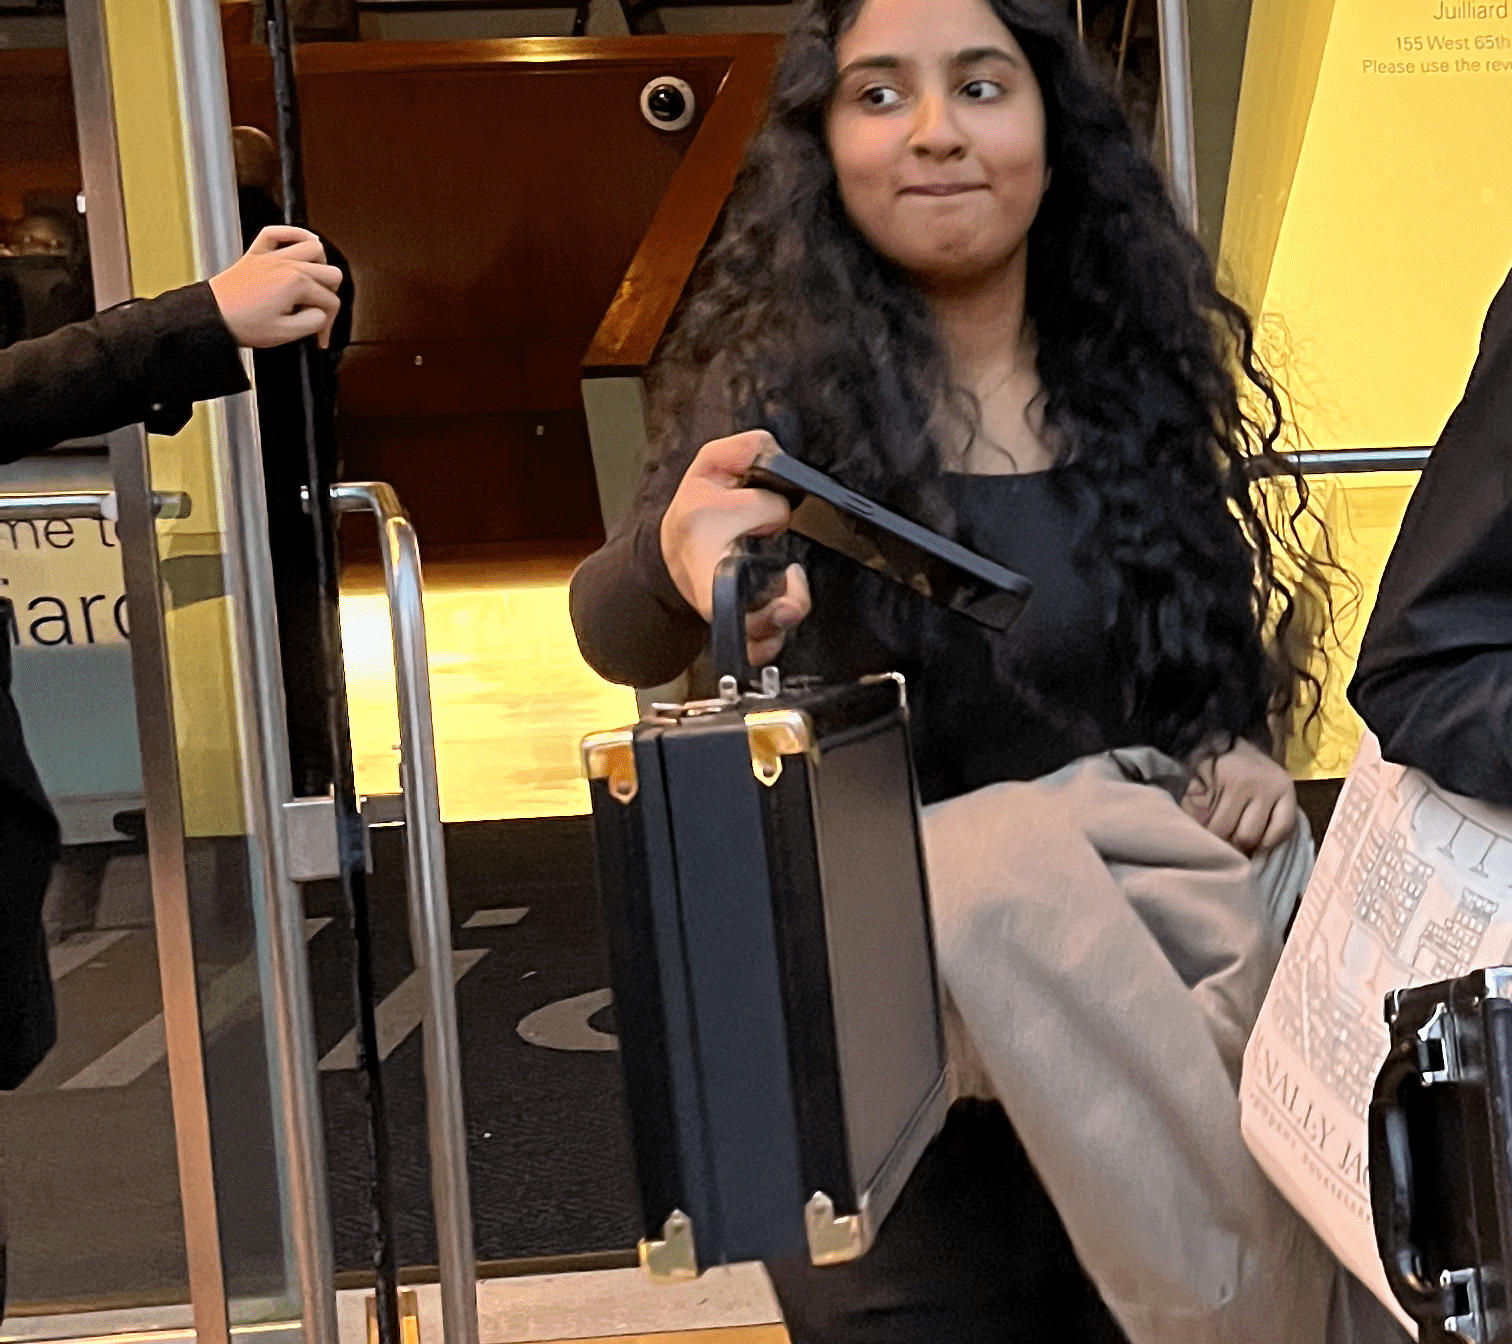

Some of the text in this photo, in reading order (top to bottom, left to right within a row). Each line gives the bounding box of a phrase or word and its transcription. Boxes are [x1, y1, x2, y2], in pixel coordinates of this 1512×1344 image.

[1432, 0, 1508, 20] Juilliard
[1396, 36, 1423, 51] 155
[1427, 35, 1470, 50] West
[1474, 34, 1511, 49] 65th
[1362, 59, 1415, 73] Please
[1420, 60, 1450, 72] use
[1455, 58, 1481, 72] the
[1253, 1035, 1335, 1148] NALLY
